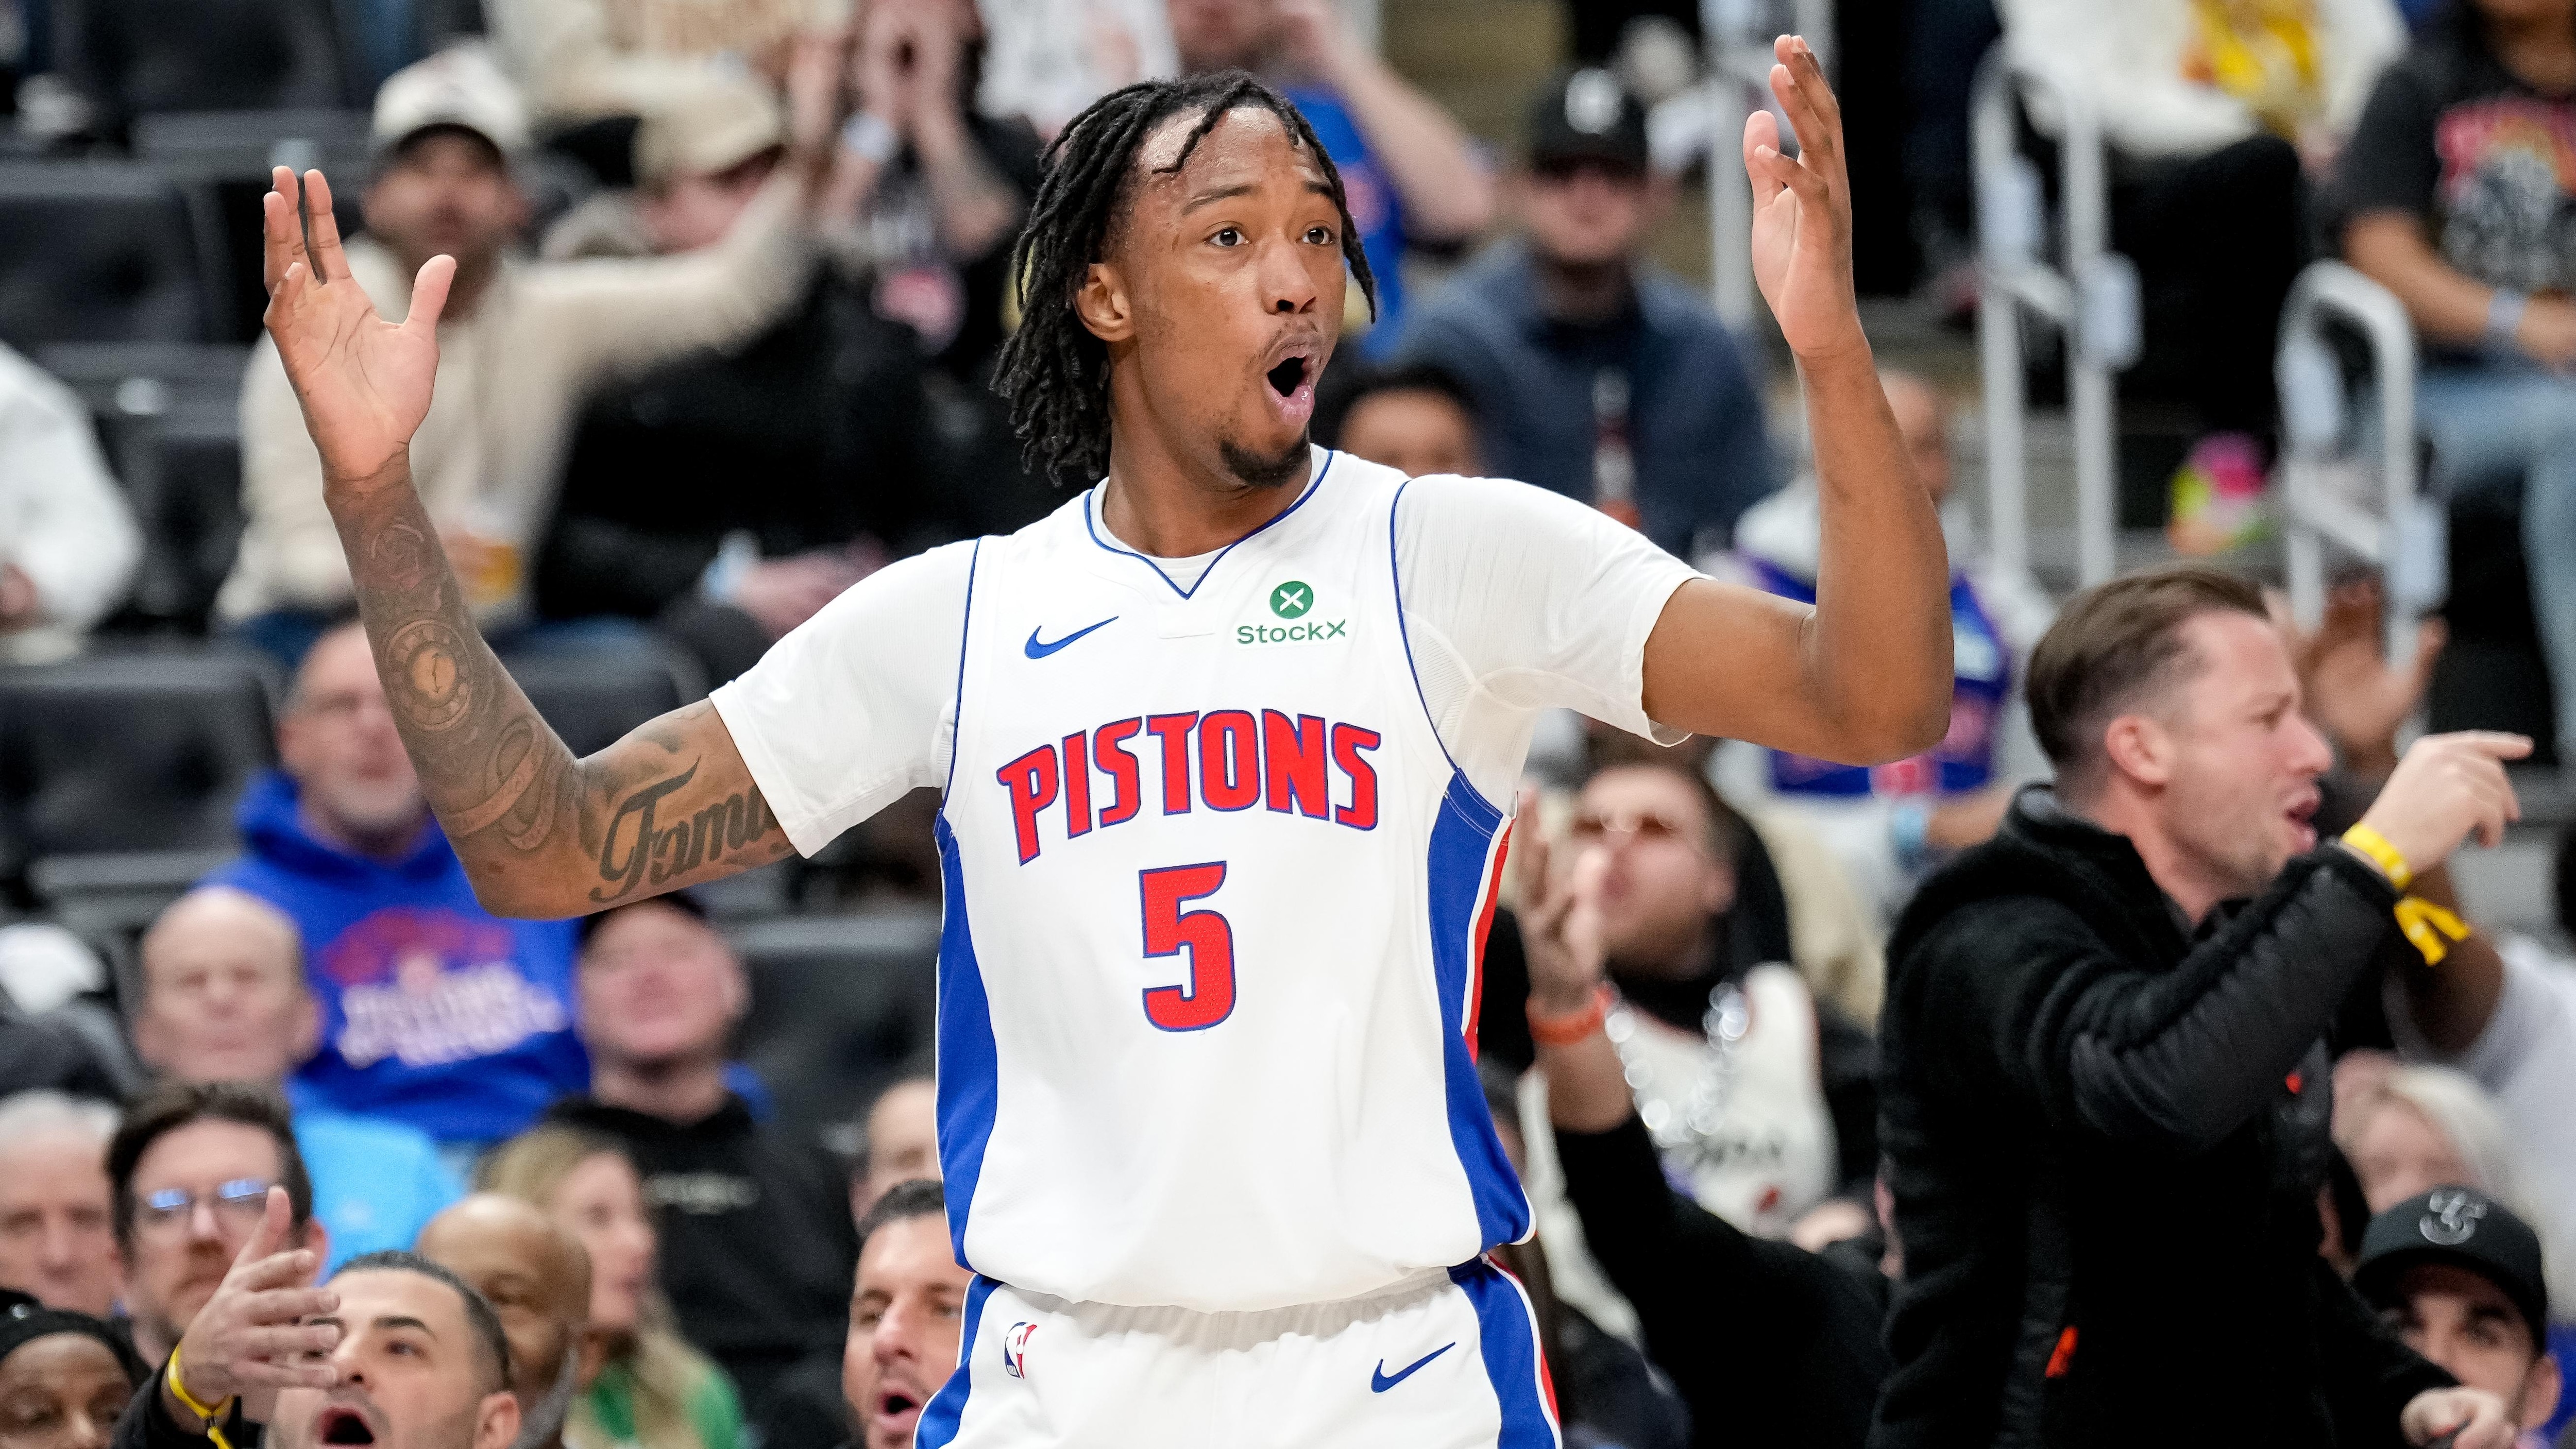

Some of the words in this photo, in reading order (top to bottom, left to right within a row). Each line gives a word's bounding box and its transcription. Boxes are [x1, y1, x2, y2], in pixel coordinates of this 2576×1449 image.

[1237, 619, 1346, 644] StockX
[996, 708, 1381, 866] PISTONS
[1139, 860, 1236, 1032] 5
